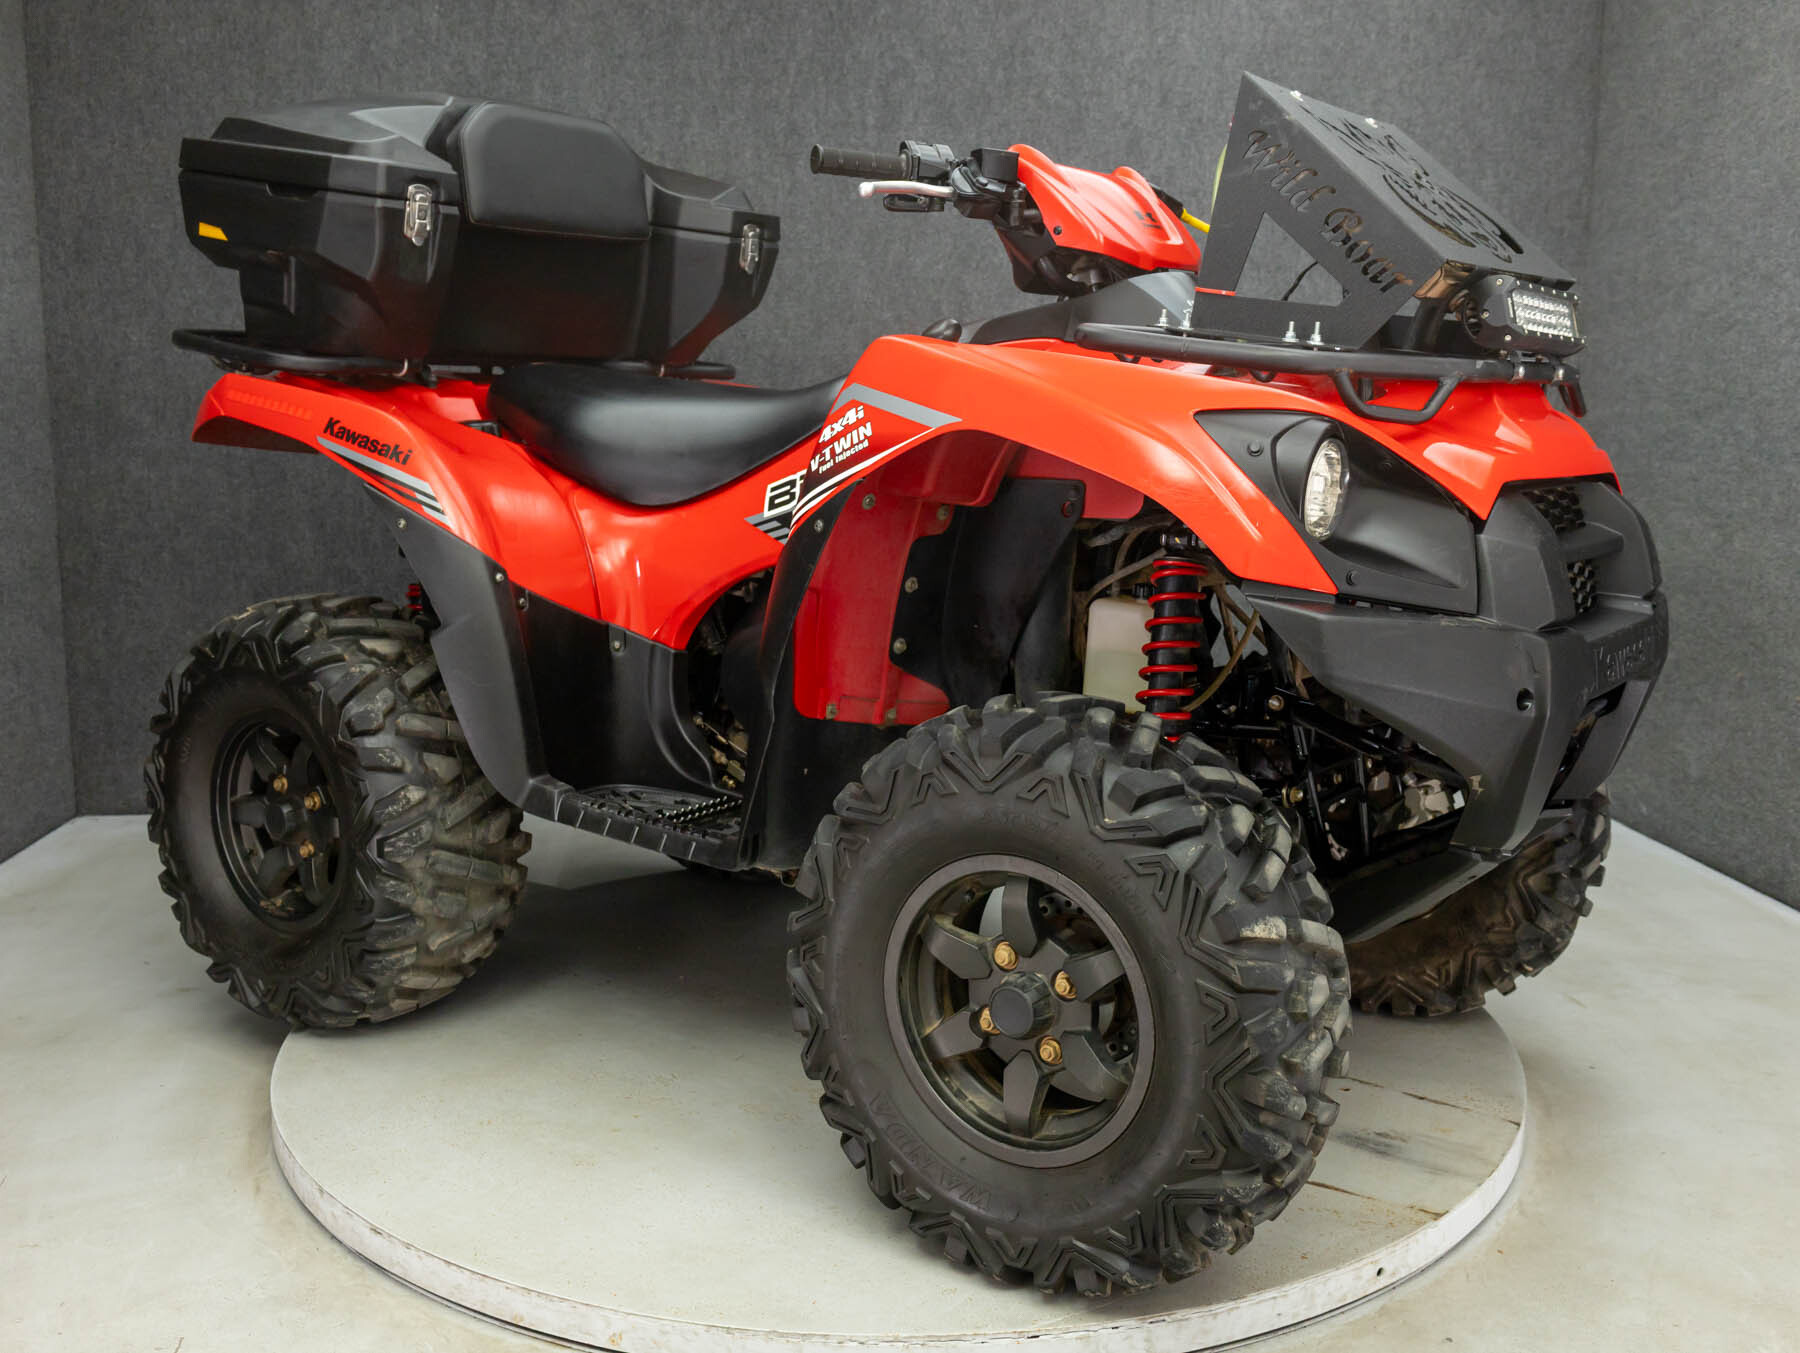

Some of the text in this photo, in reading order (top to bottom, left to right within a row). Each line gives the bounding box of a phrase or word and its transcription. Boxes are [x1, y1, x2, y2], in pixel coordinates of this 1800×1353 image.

[1242, 130, 1413, 293] Wild Boar
[323, 417, 413, 466] Kawasaki
[810, 421, 873, 472] V-TWIN
[818, 405, 865, 444] 4x4i
